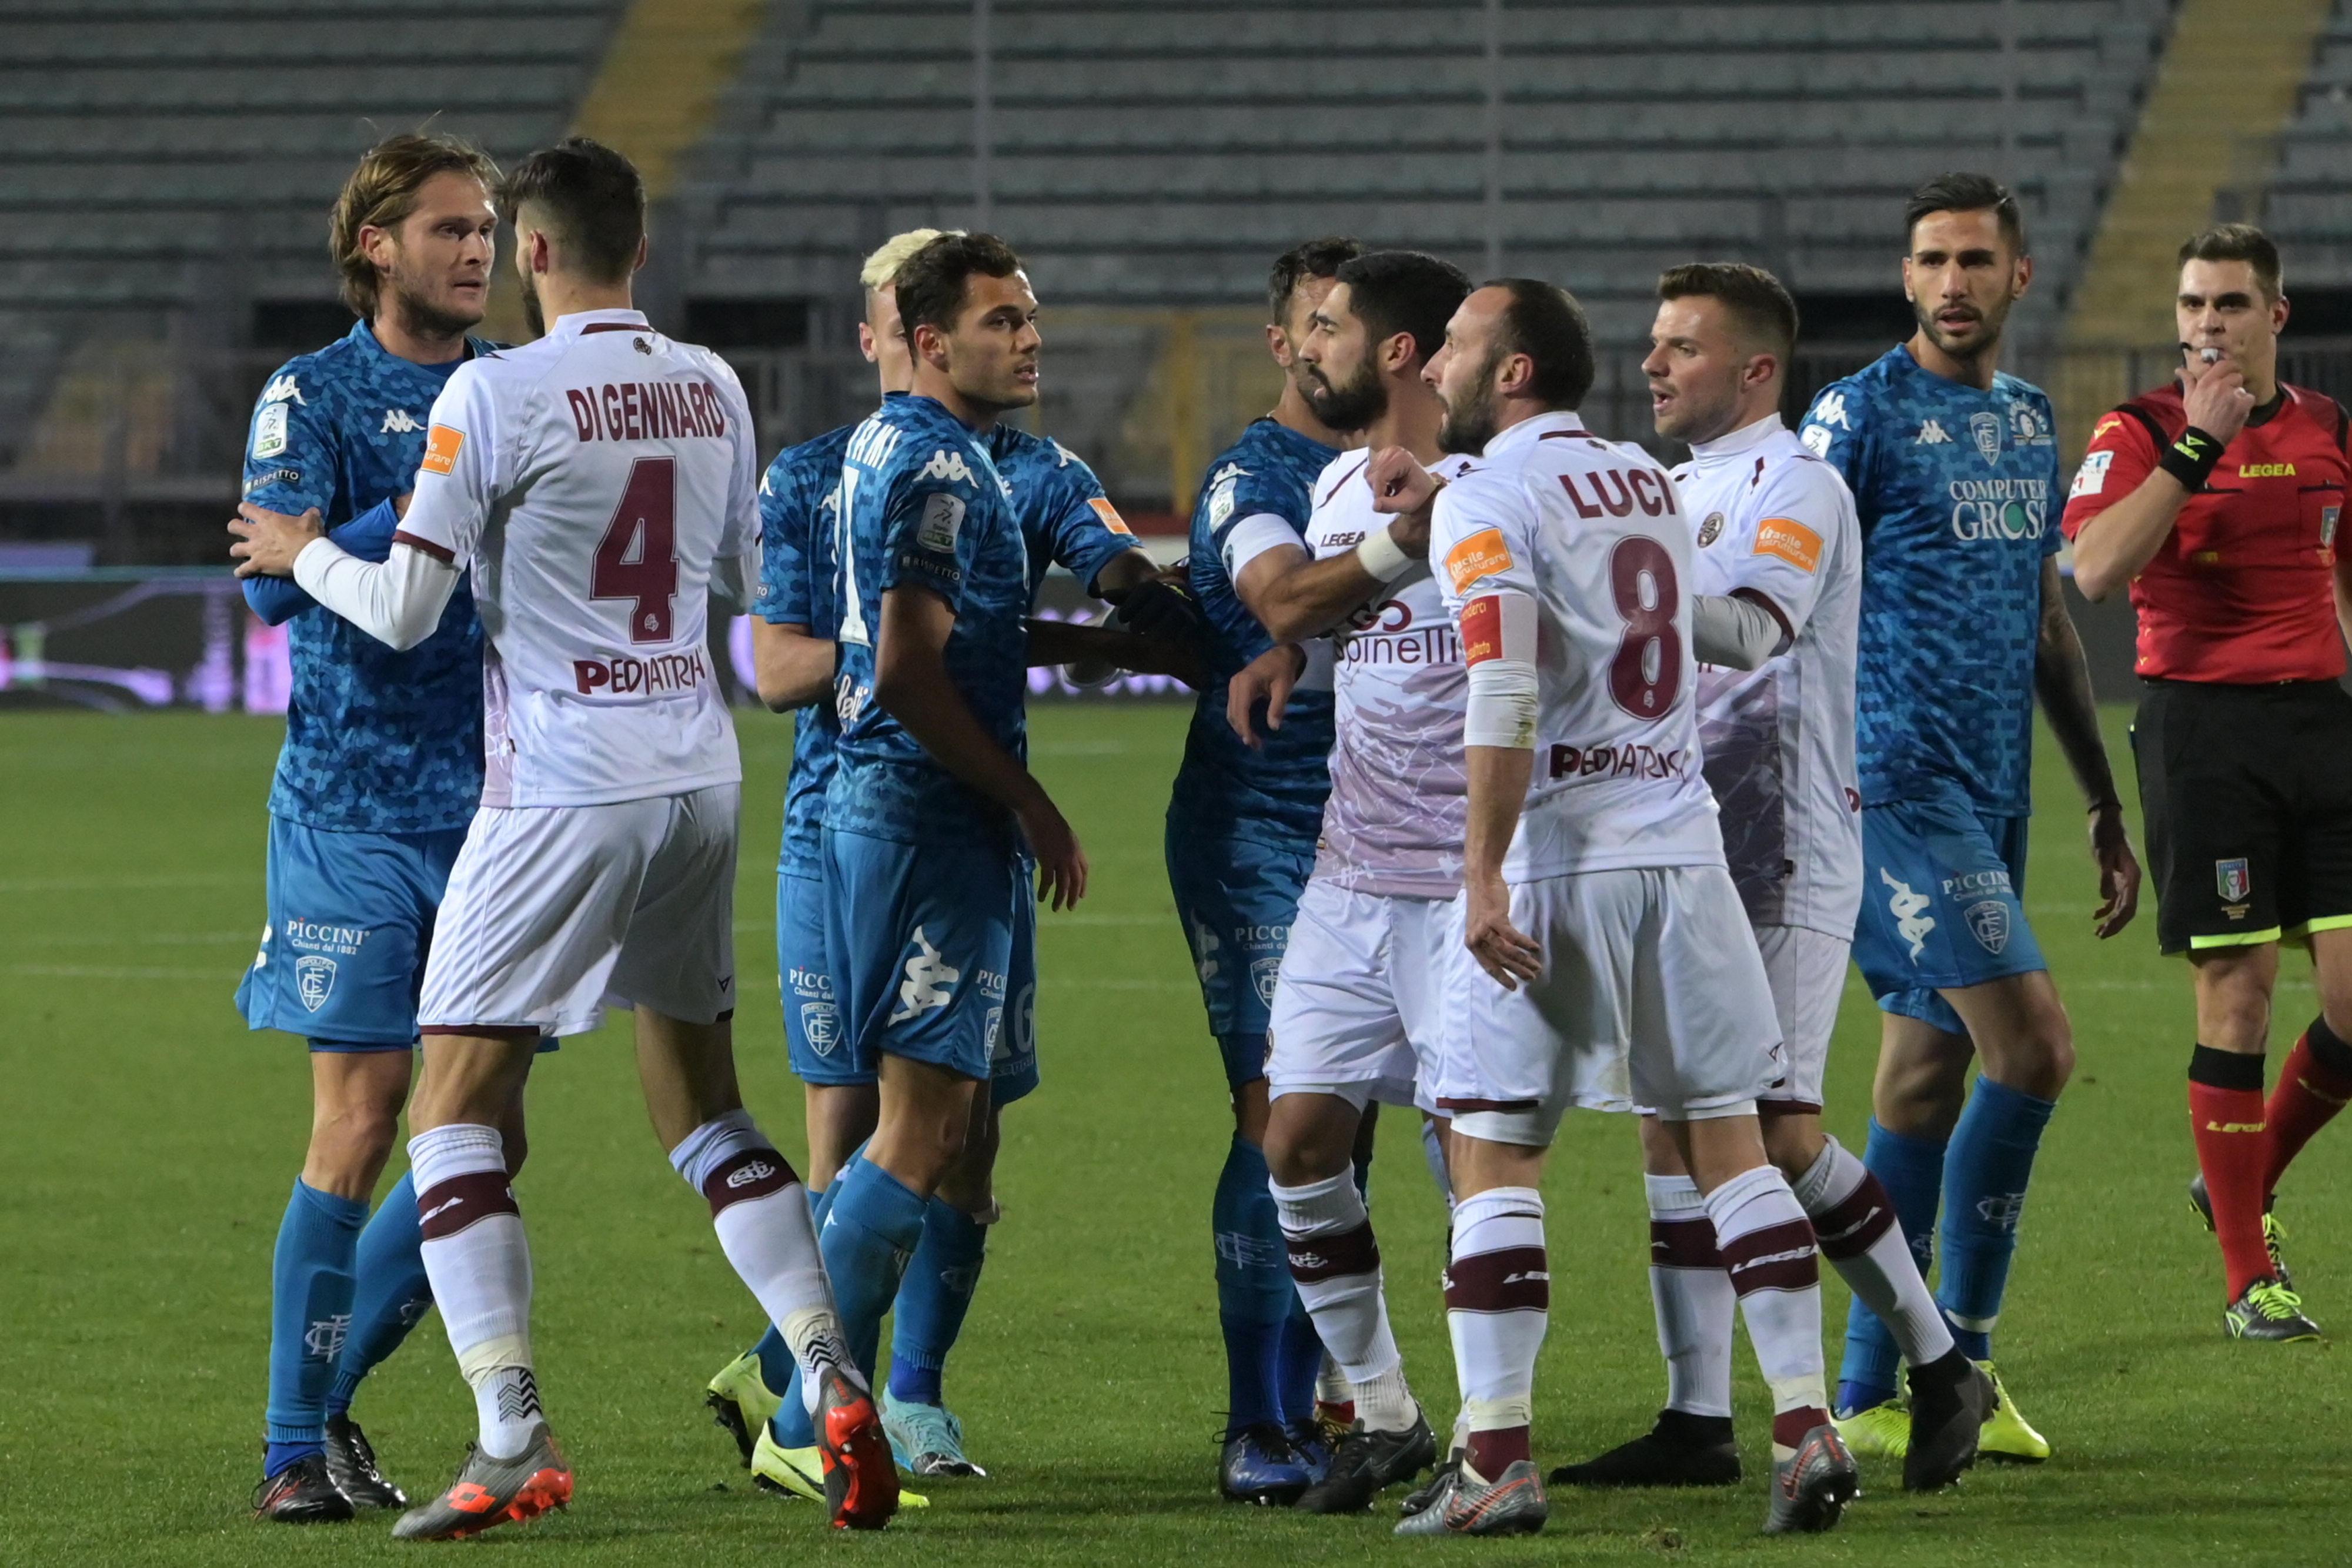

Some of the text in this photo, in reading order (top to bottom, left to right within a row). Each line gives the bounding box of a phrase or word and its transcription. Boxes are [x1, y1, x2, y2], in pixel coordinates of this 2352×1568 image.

[566, 382, 725, 442] DI GENNARO
[253, 470, 299, 486] RISPETTO
[2239, 463, 2296, 477] LEGEA
[1558, 469, 1676, 519] LUCI
[1949, 479, 2047, 501] COMPUTER
[1952, 499, 2048, 541] GROSS
[590, 456, 679, 644] 4
[1320, 531, 1365, 547] LEGEA
[913, 557, 960, 581] RISPETTO
[1608, 534, 1682, 720] 8
[1942, 871, 2011, 895] PICCIN
[292, 939, 320, 951] Chianti
[322, 943, 334, 952] dal
[1242, 942, 1274, 950] Chianti
[789, 967, 831, 990] PICC
